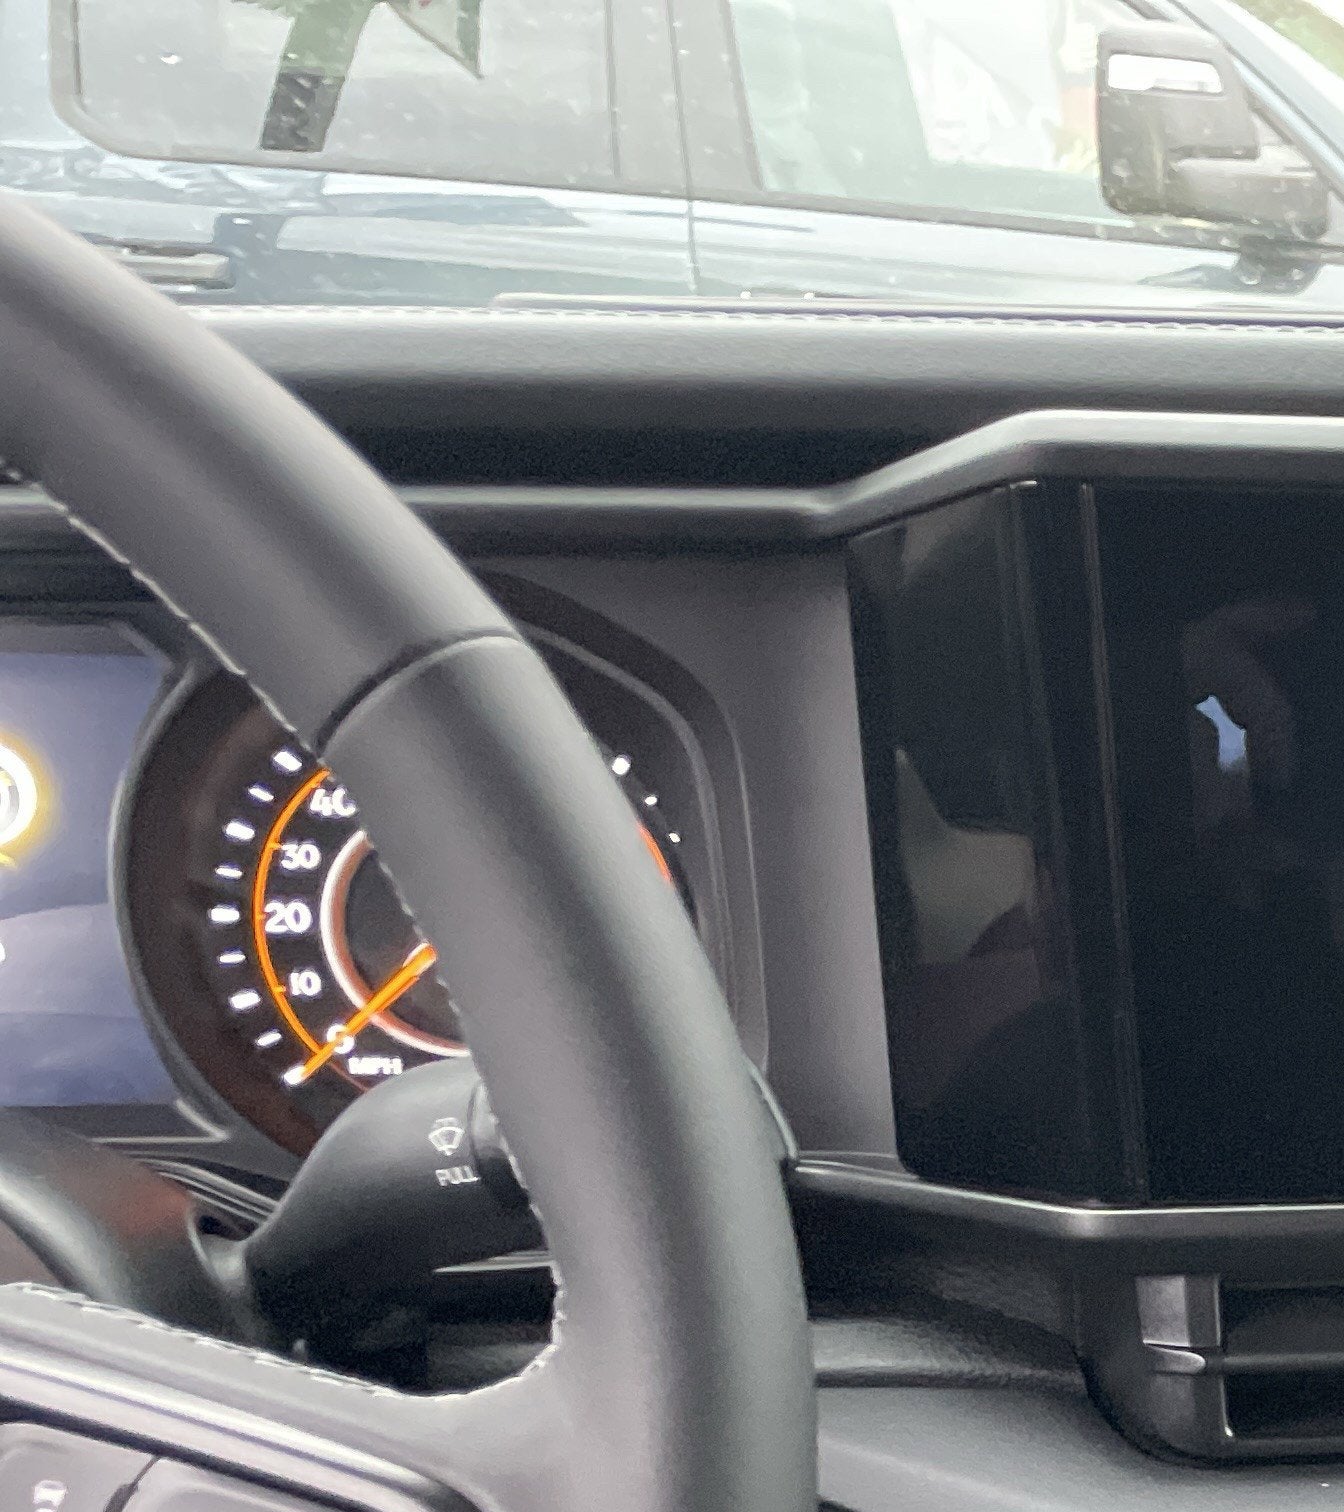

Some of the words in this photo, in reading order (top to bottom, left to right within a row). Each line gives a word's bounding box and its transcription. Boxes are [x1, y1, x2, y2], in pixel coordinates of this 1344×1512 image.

[280, 842, 322, 871] 30
[264, 900, 313, 934] 20
[288, 969, 322, 997] 10
